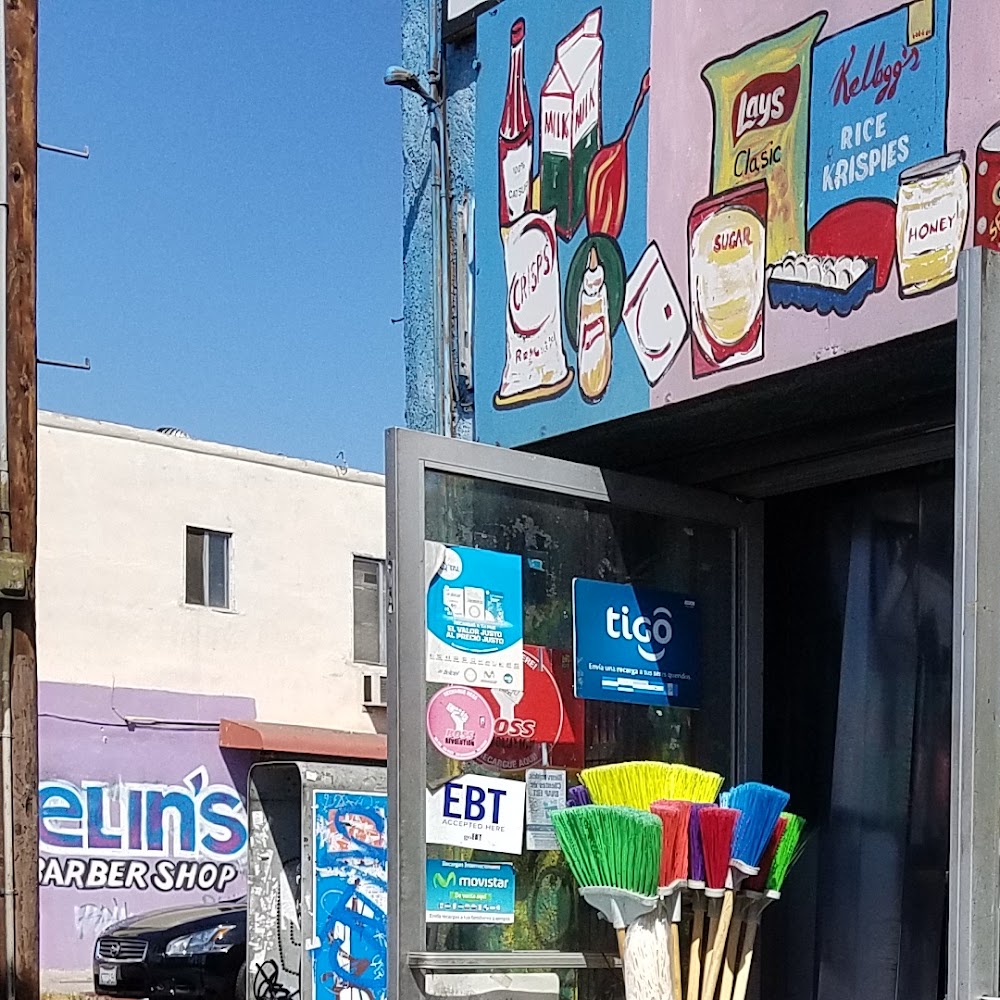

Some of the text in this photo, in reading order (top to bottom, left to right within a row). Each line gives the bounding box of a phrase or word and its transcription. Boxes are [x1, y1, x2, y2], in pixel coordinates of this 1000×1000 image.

[829, 41, 921, 107] Kellogg's
[736, 86, 785, 137] Lays
[840, 112, 888, 150] RICE
[733, 144, 782, 178] Clasic
[822, 135, 910, 192] KRISPIES
[713, 226, 753, 253] SUGAR
[908, 213, 956, 243] HONEY
[513, 243, 550, 311] CRISPS
[606, 605, 673, 662] tigo
[493, 719, 536, 737] OSS
[442, 782, 507, 824] EBT
[442, 819, 483, 830] ACCEPTED
[151, 860, 238, 892] SHOP
[459, 877, 508, 888] movistar
